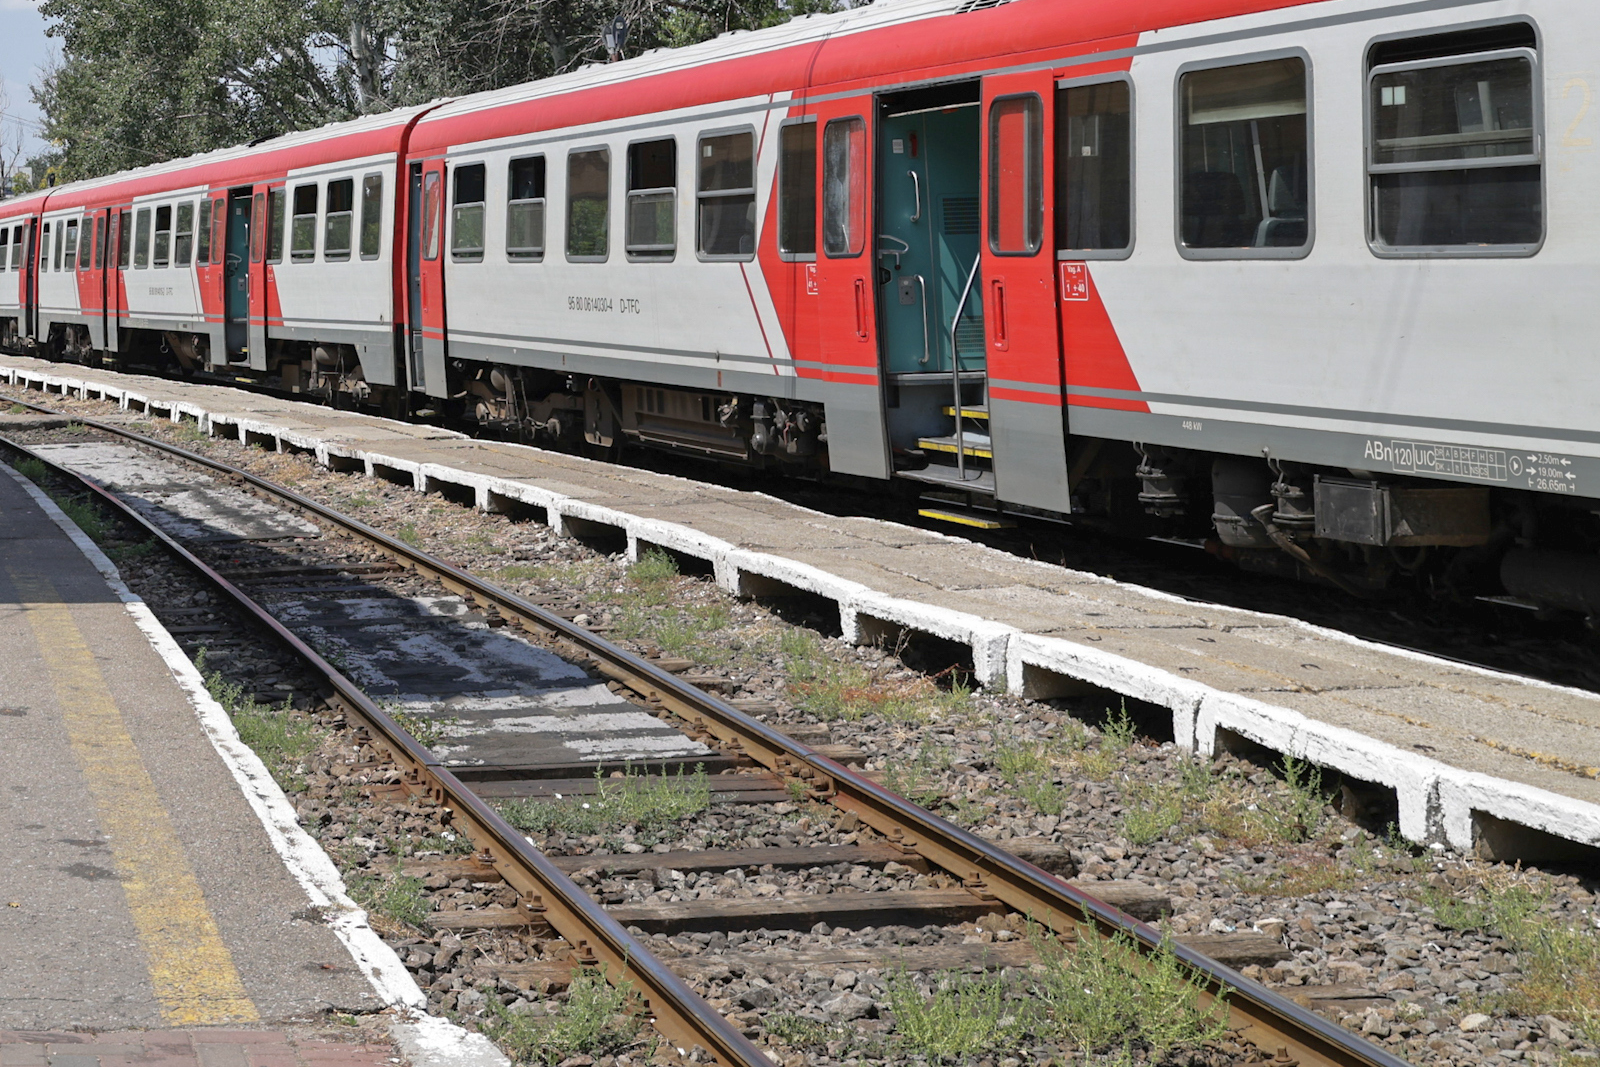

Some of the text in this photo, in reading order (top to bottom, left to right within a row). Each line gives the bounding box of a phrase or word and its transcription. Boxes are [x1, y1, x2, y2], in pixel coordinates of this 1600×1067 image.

[620, 298, 640, 314] D-TFC
[1364, 439, 1436, 466] ABn 120 UIC
[1445, 449, 1451, 457] A
[1453, 449, 1459, 458] B
[1471, 451, 1476, 460] F
